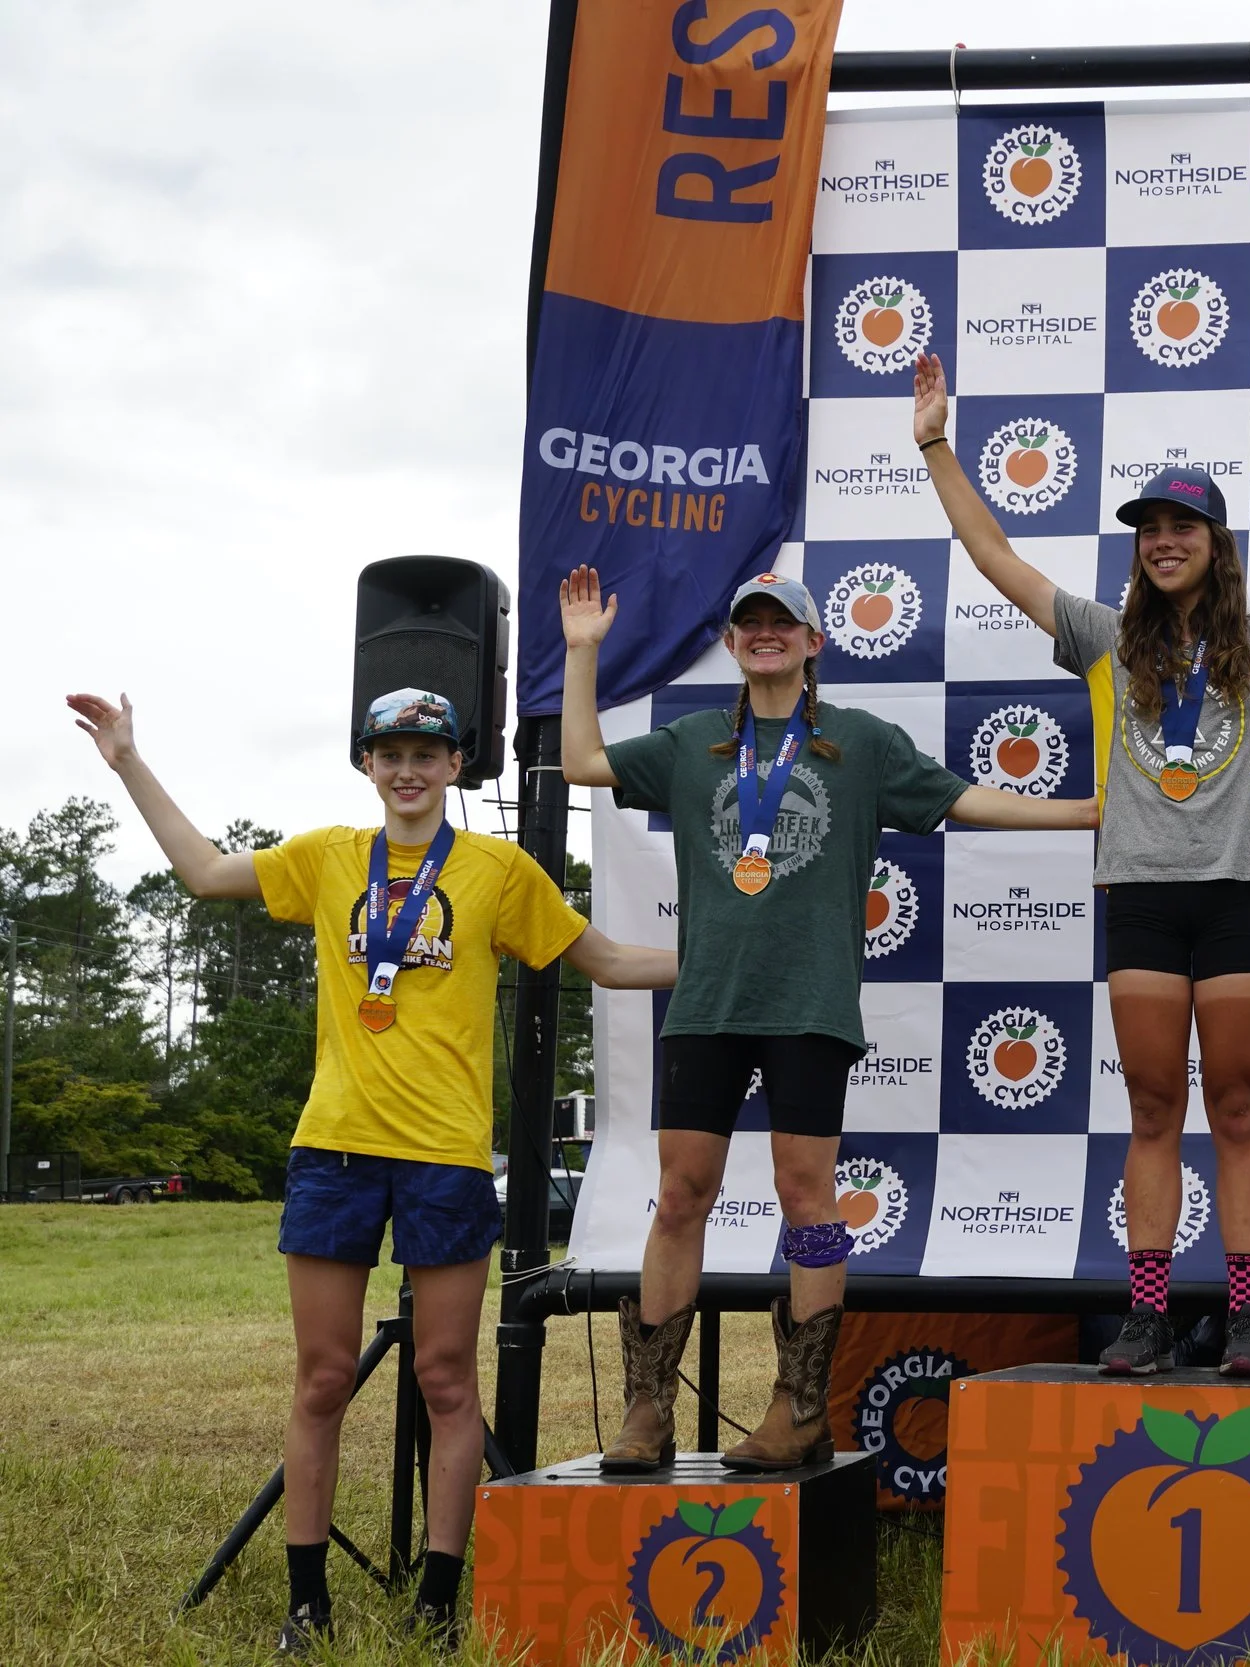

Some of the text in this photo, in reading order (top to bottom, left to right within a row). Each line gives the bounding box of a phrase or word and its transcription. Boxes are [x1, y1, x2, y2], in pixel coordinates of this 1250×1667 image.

[822, 173, 949, 192] NORTHSIDE
[990, 131, 1050, 193] GEORGIA
[1116, 166, 1246, 184] NORTHSIDE
[845, 192, 925, 203] HOSPITAL
[1012, 155, 1075, 217] CYCLING
[1140, 185, 1222, 196] HOSPITAL
[842, 283, 904, 343] GEORGIA
[967, 317, 1096, 333] NORTHSIDE
[1137, 275, 1199, 336] GEORGIA
[863, 306, 926, 366] CYCLING
[991, 335, 1072, 345] HOSPITAL
[1159, 298, 1223, 360] CYCLING
[539, 426, 770, 485] GEORGIA
[816, 468, 930, 483] NORTHSID
[986, 424, 1049, 484] GEORGIA
[839, 485, 920, 495] HOSPITAL
[1007, 446, 1071, 507] CYCLING
[580, 482, 725, 532] CYCLING
[831, 569, 894, 628] GEORGIA
[851, 591, 915, 651] CYCLING
[776, 733, 794, 767] GEORGIA
[977, 711, 1040, 774] GEORGIA
[1213, 719, 1232, 757] TEAM
[775, 815, 821, 835] REEK
[370, 881, 378, 919] GEORGIA
[412, 860, 434, 896] GEORGIA
[865, 888, 912, 951] YCLING
[954, 903, 1085, 918] NORTHSIDE
[978, 921, 1060, 930] HOSPITAL
[424, 957, 452, 970] TEAM
[973, 1013, 1039, 1076] GEORGIA
[849, 1076, 908, 1085] SPITAL
[995, 1038, 1060, 1102] CYCLING
[835, 1164, 883, 1187] RGIA
[854, 1189, 902, 1246] CLING
[941, 1207, 1074, 1221] NORTHSIDE
[963, 1224, 1046, 1233] HOSPITAL
[862, 1356, 952, 1452] GEORGIA
[1170, 1508, 1202, 1613] 1
[691, 1561, 725, 1628] 2
